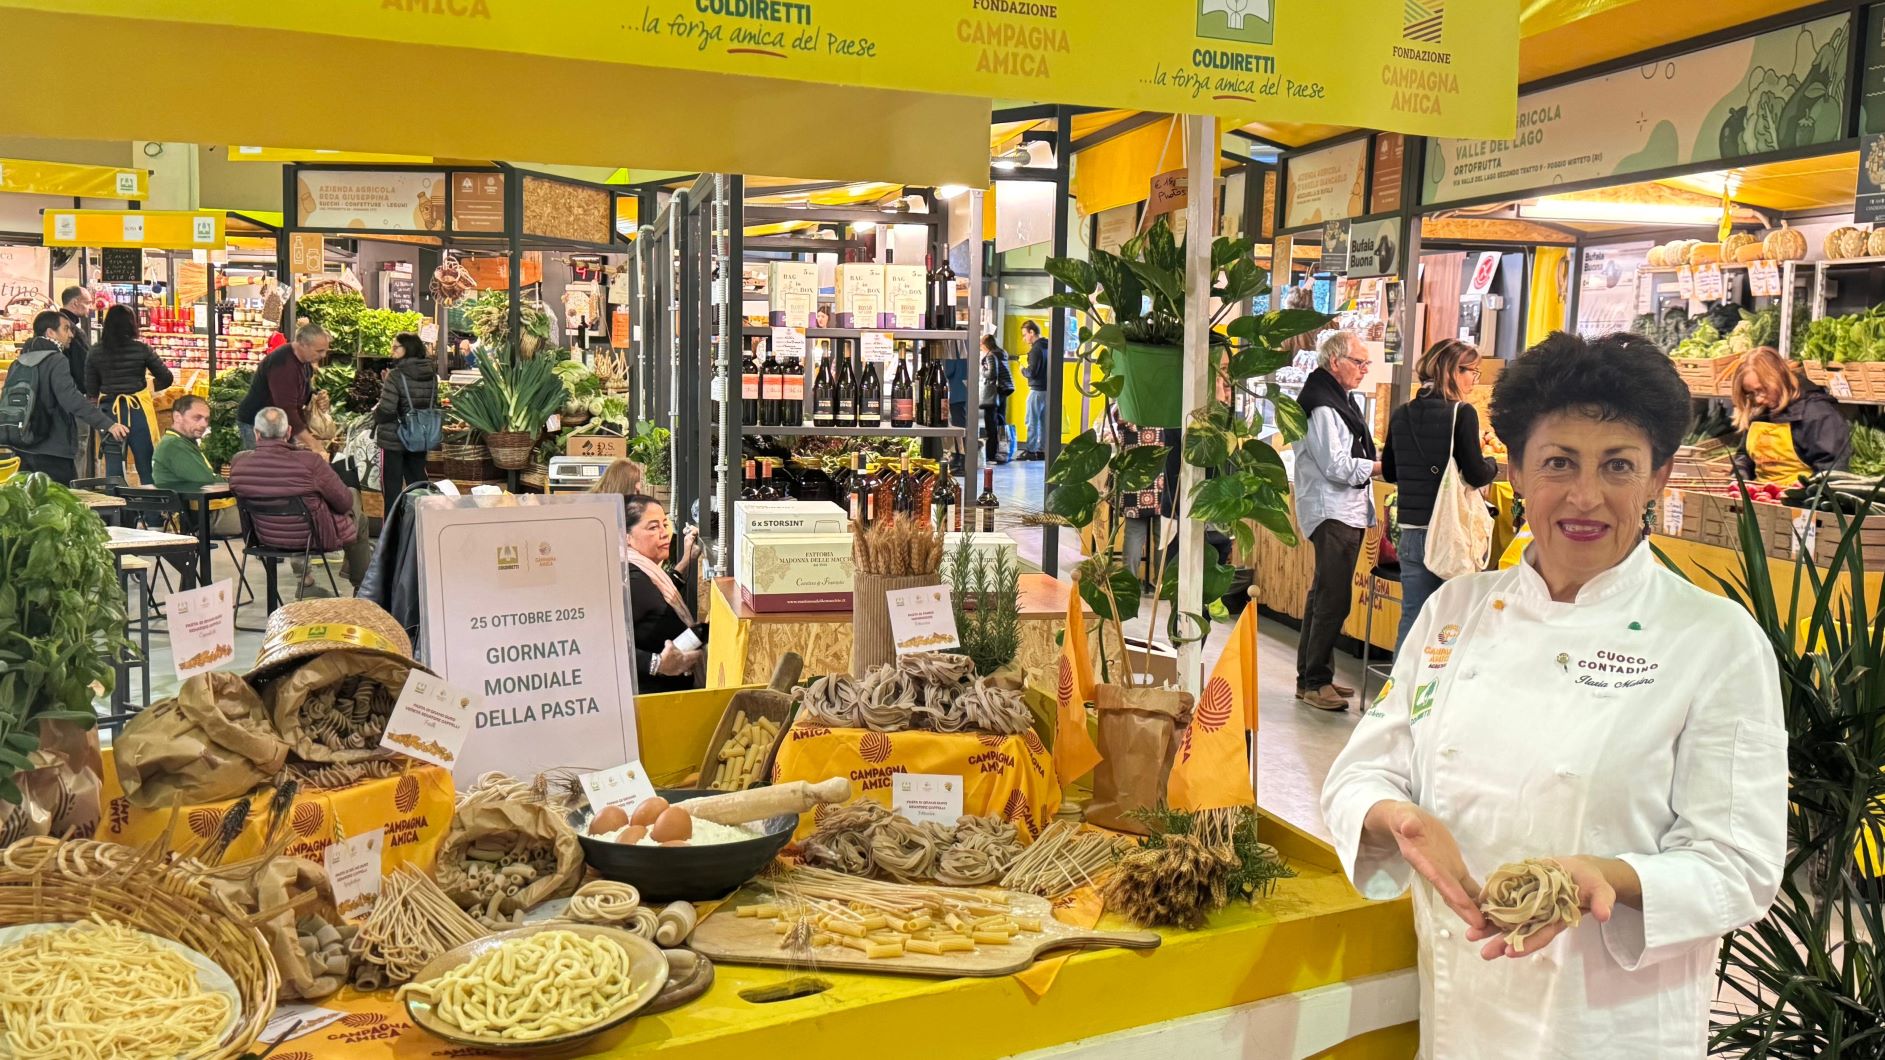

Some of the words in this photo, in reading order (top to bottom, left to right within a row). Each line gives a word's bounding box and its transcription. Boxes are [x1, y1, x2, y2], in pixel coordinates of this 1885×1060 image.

[695, 0, 811, 25] COLDIRETTI
[973, 0, 1057, 18] FONDAZIONE
[729, 24, 783, 48] amica
[792, 26, 819, 51] del
[825, 33, 877, 57] Paese
[956, 18, 1070, 53] CAMPAGNA
[975, 48, 1050, 78] AMICA
[1192, 49, 1274, 74] COLDIRETTI
[1392, 46, 1451, 64] FONDAZIONE
[1215, 74, 1255, 94] amica
[1259, 74, 1281, 95] del
[1286, 79, 1325, 98] Paese
[1381, 64, 1459, 94] CAMPAGNA
[1391, 90, 1442, 116] AMICA
[1516, 104, 1561, 128] RICOLA
[1456, 140, 1487, 160] VALLE
[1513, 128, 1543, 149] LAGO
[1453, 157, 1502, 176] ORTOFRUTTA
[1351, 239, 1374, 252] Bufala
[1350, 255, 1373, 267] Buona
[1355, 571, 1389, 597] CAMGNA
[470, 616, 487, 630] 25
[492, 610, 553, 628] OTTOBRE
[555, 607, 585, 622] 2025
[486, 638, 581, 665] GIORNATA
[1596, 649, 1647, 665] CUOCO
[1577, 659, 1658, 674] CONTADINO
[484, 668, 583, 697] MONDIALE
[475, 705, 537, 730] DELLA
[541, 697, 600, 721] PASTA
[793, 729, 832, 741] AMICA
[850, 764, 907, 781] CAMPAGNA
[861, 777, 892, 791] AMIC
[110, 799, 122, 834] CAMP
[384, 815, 429, 836] CAMPAGNA
[1023, 805, 1040, 841] CAMP
[390, 829, 420, 848] AMICA
[327, 1021, 412, 1042] CAMPAGNA
[345, 1028, 401, 1044] AMICA
